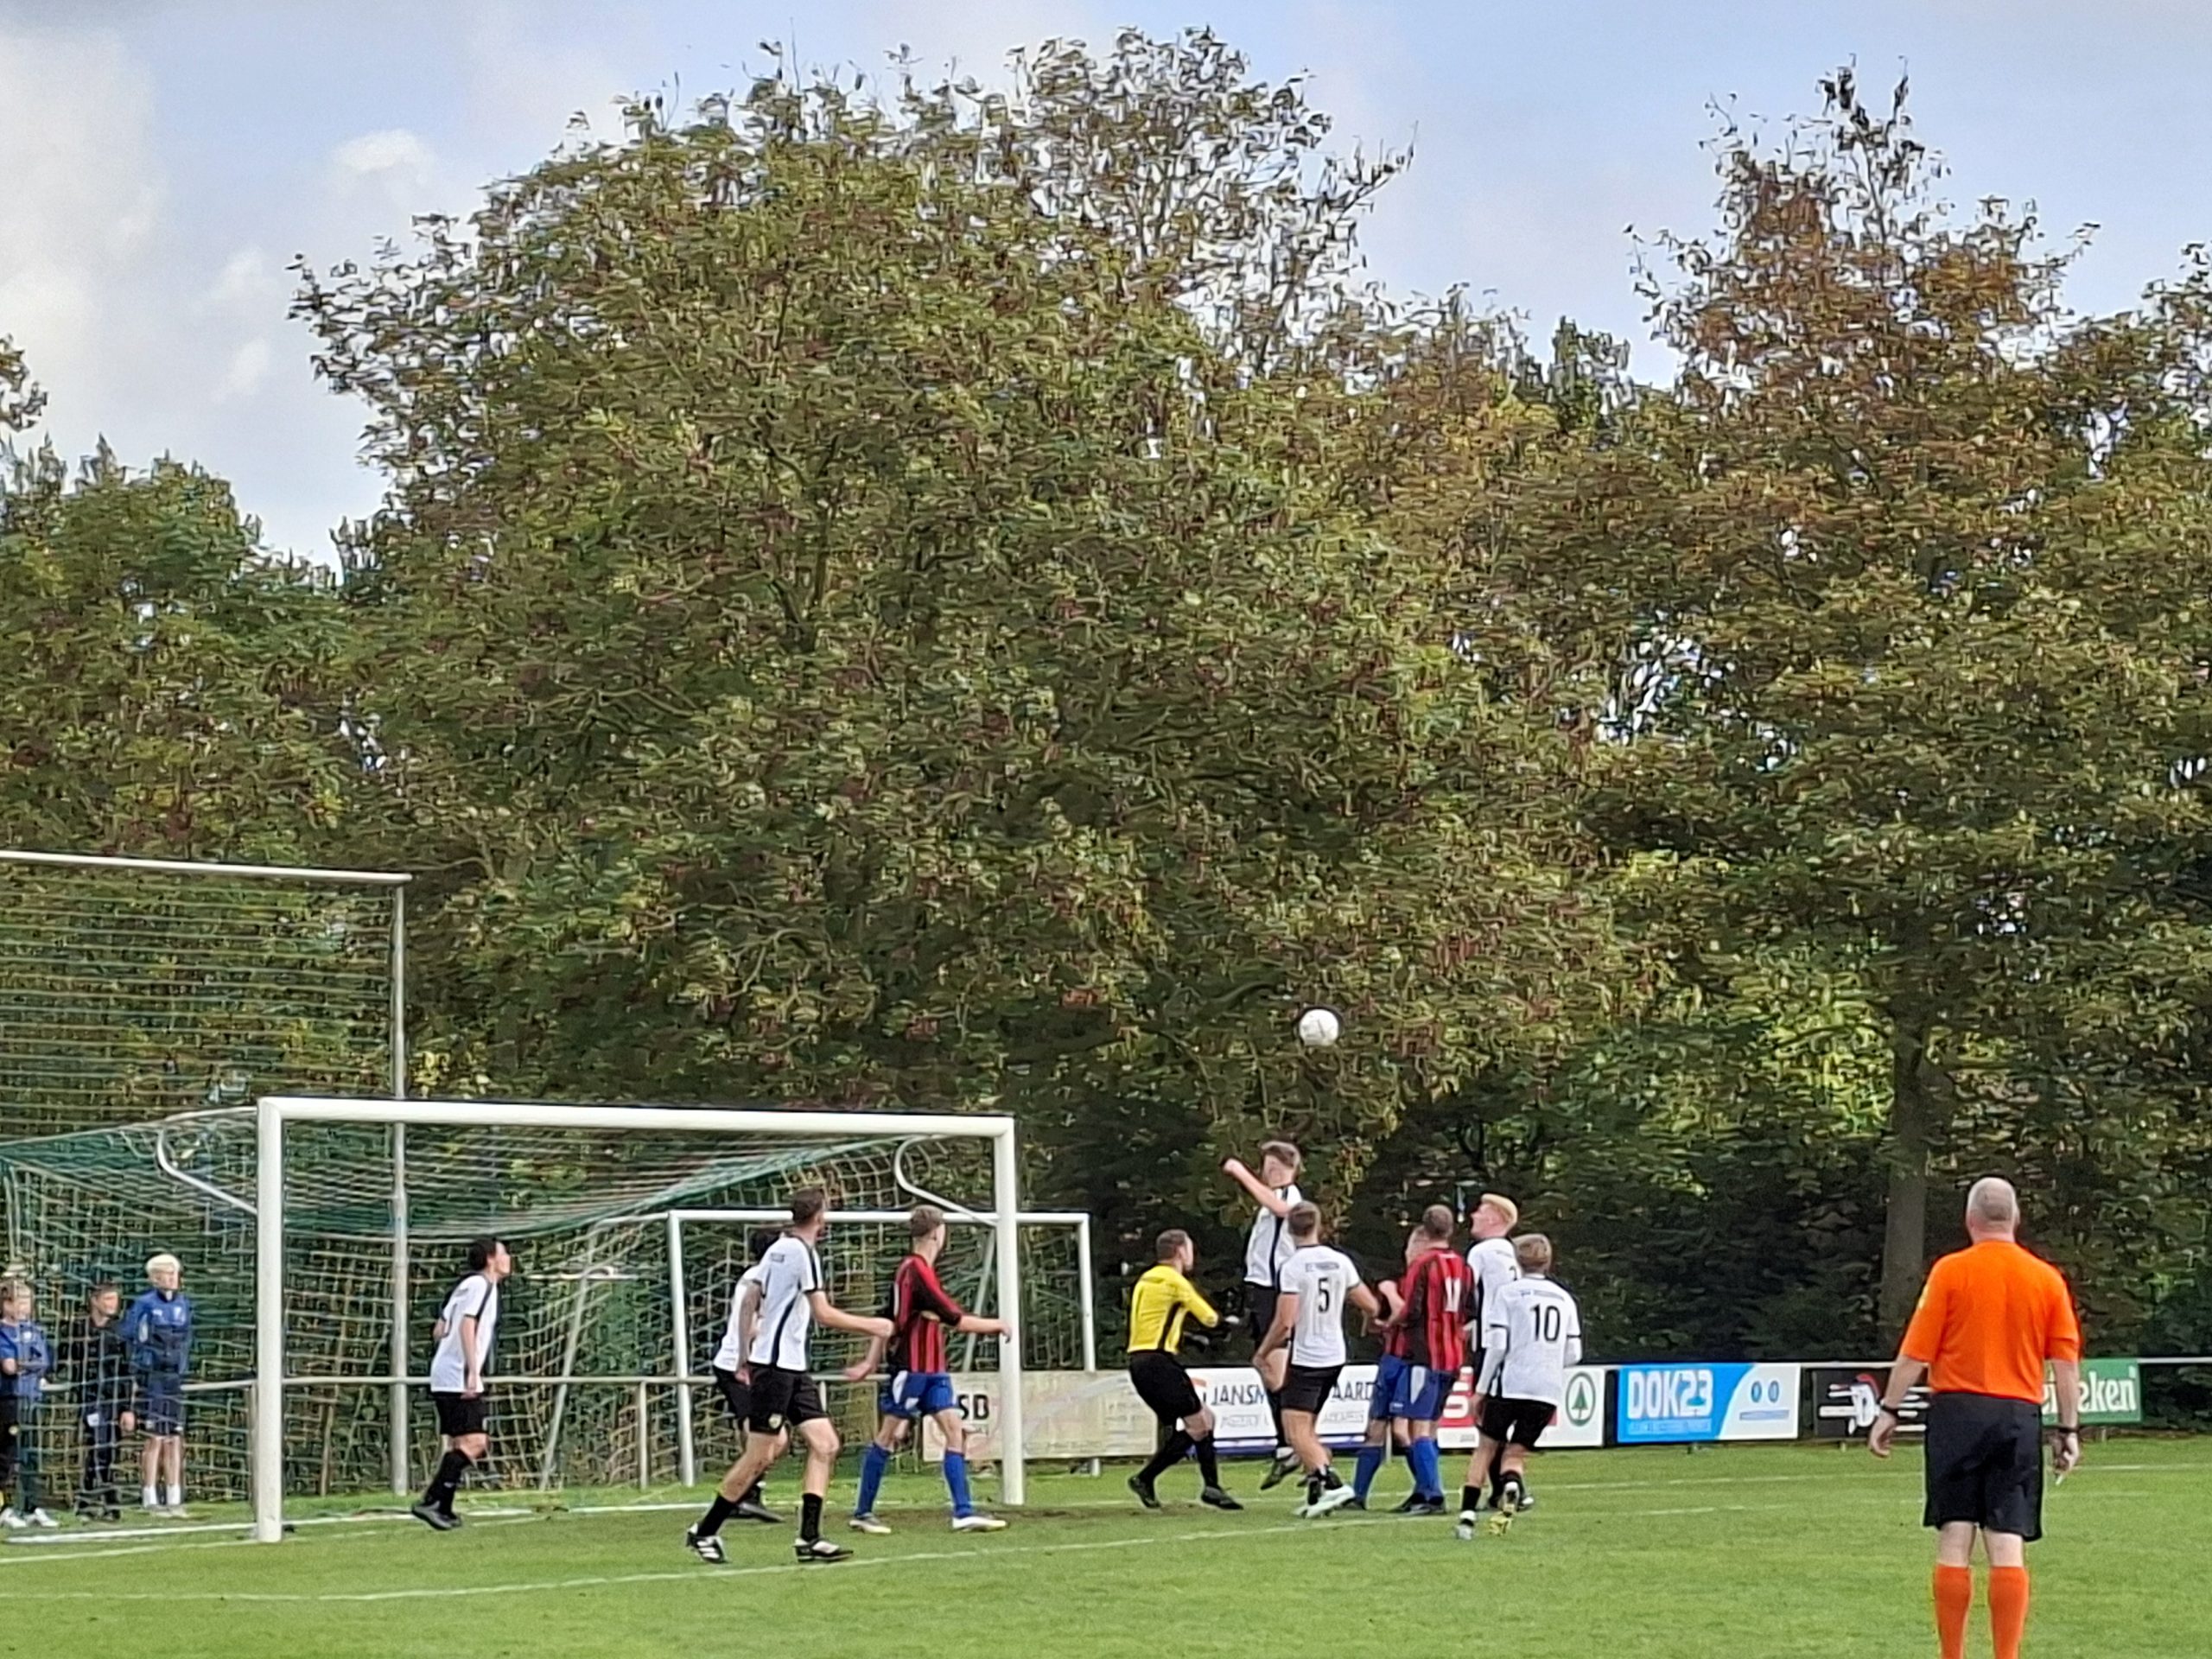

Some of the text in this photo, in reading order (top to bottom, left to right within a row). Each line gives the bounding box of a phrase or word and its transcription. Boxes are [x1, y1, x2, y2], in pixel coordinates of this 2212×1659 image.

[1317, 1277, 1331, 1313] 5
[1530, 1303, 1560, 1342] 10
[1627, 1370, 1713, 1420] DOK23
